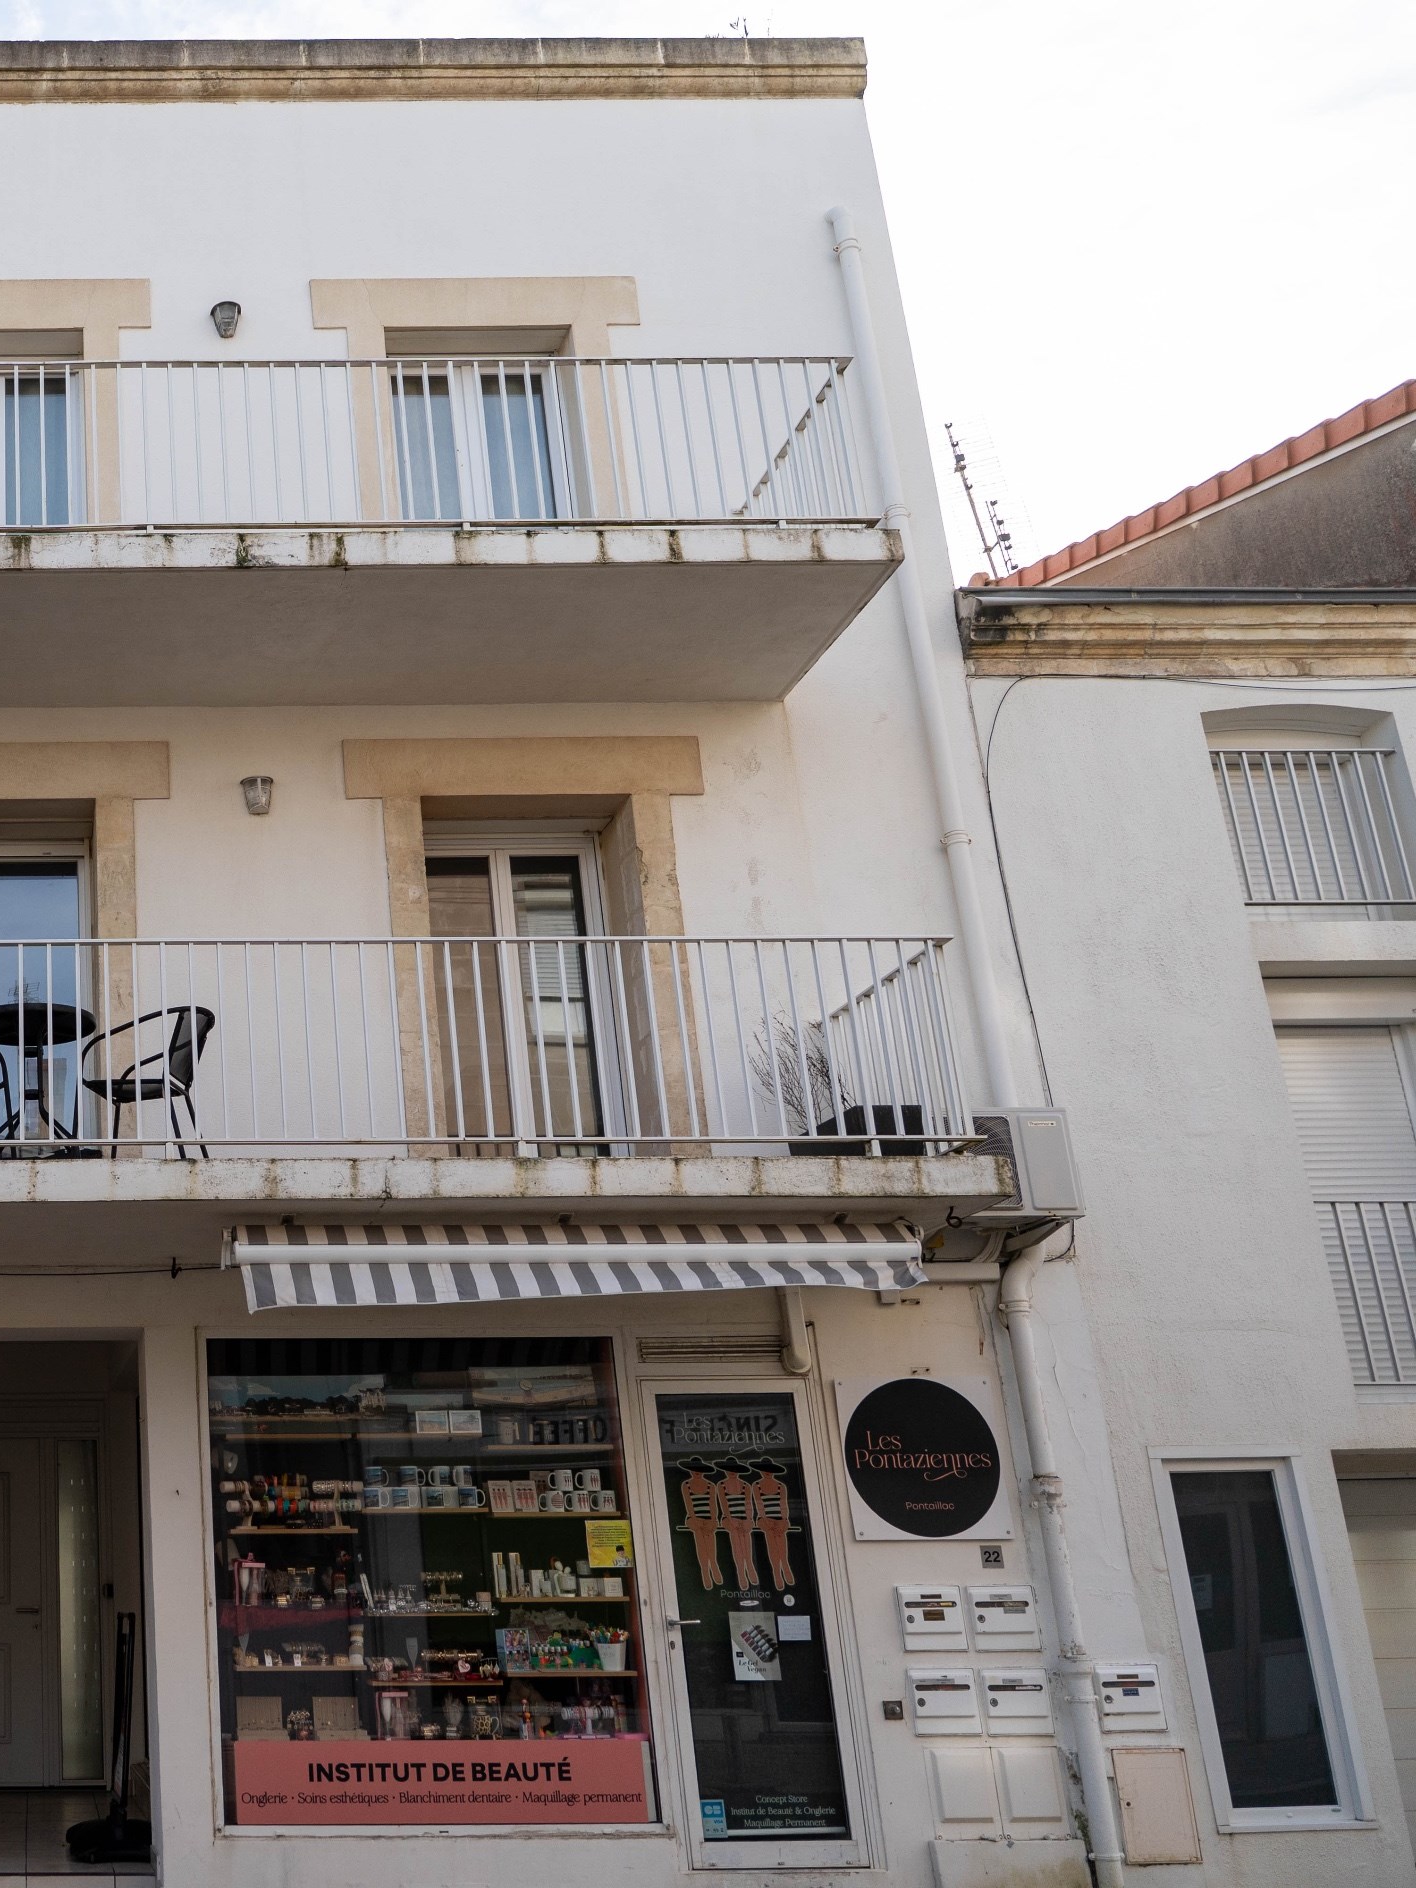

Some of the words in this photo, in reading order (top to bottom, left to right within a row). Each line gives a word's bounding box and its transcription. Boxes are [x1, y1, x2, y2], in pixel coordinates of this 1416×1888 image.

[683, 1411, 712, 1429] Les
[673, 1427, 785, 1454] Pontaziennes
[865, 1430, 902, 1450] Les
[854, 1448, 992, 1481] Pontaziennes
[905, 1501, 955, 1510] Pontaillac
[983, 1550, 1001, 1563] 22
[720, 1589, 771, 1599] Pontaillac
[747, 1665, 767, 1673] Vegan
[308, 1762, 426, 1783] INSTITUT
[432, 1762, 466, 1782] DE
[471, 1757, 572, 1782] BEAUTÉ
[241, 1791, 288, 1807] Onglerie
[297, 1791, 327, 1804] Soins
[329, 1791, 389, 1807] esthétiques
[399, 1791, 466, 1804] Blanchiment
[468, 1791, 511, 1803] dentaire
[522, 1790, 580, 1806] Maquillage
[583, 1792, 642, 1806] permanent
[755, 1795, 787, 1804] Concept
[788, 1795, 808, 1803] Store
[731, 1807, 755, 1816] Institut
[757, 1807, 766, 1815] de
[768, 1806, 792, 1815] Beauté
[795, 1806, 802, 1815] &
[803, 1806, 836, 1816] Onglerie
[744, 1818, 783, 1829] Maquillage
[785, 1818, 826, 1827] Permanent
